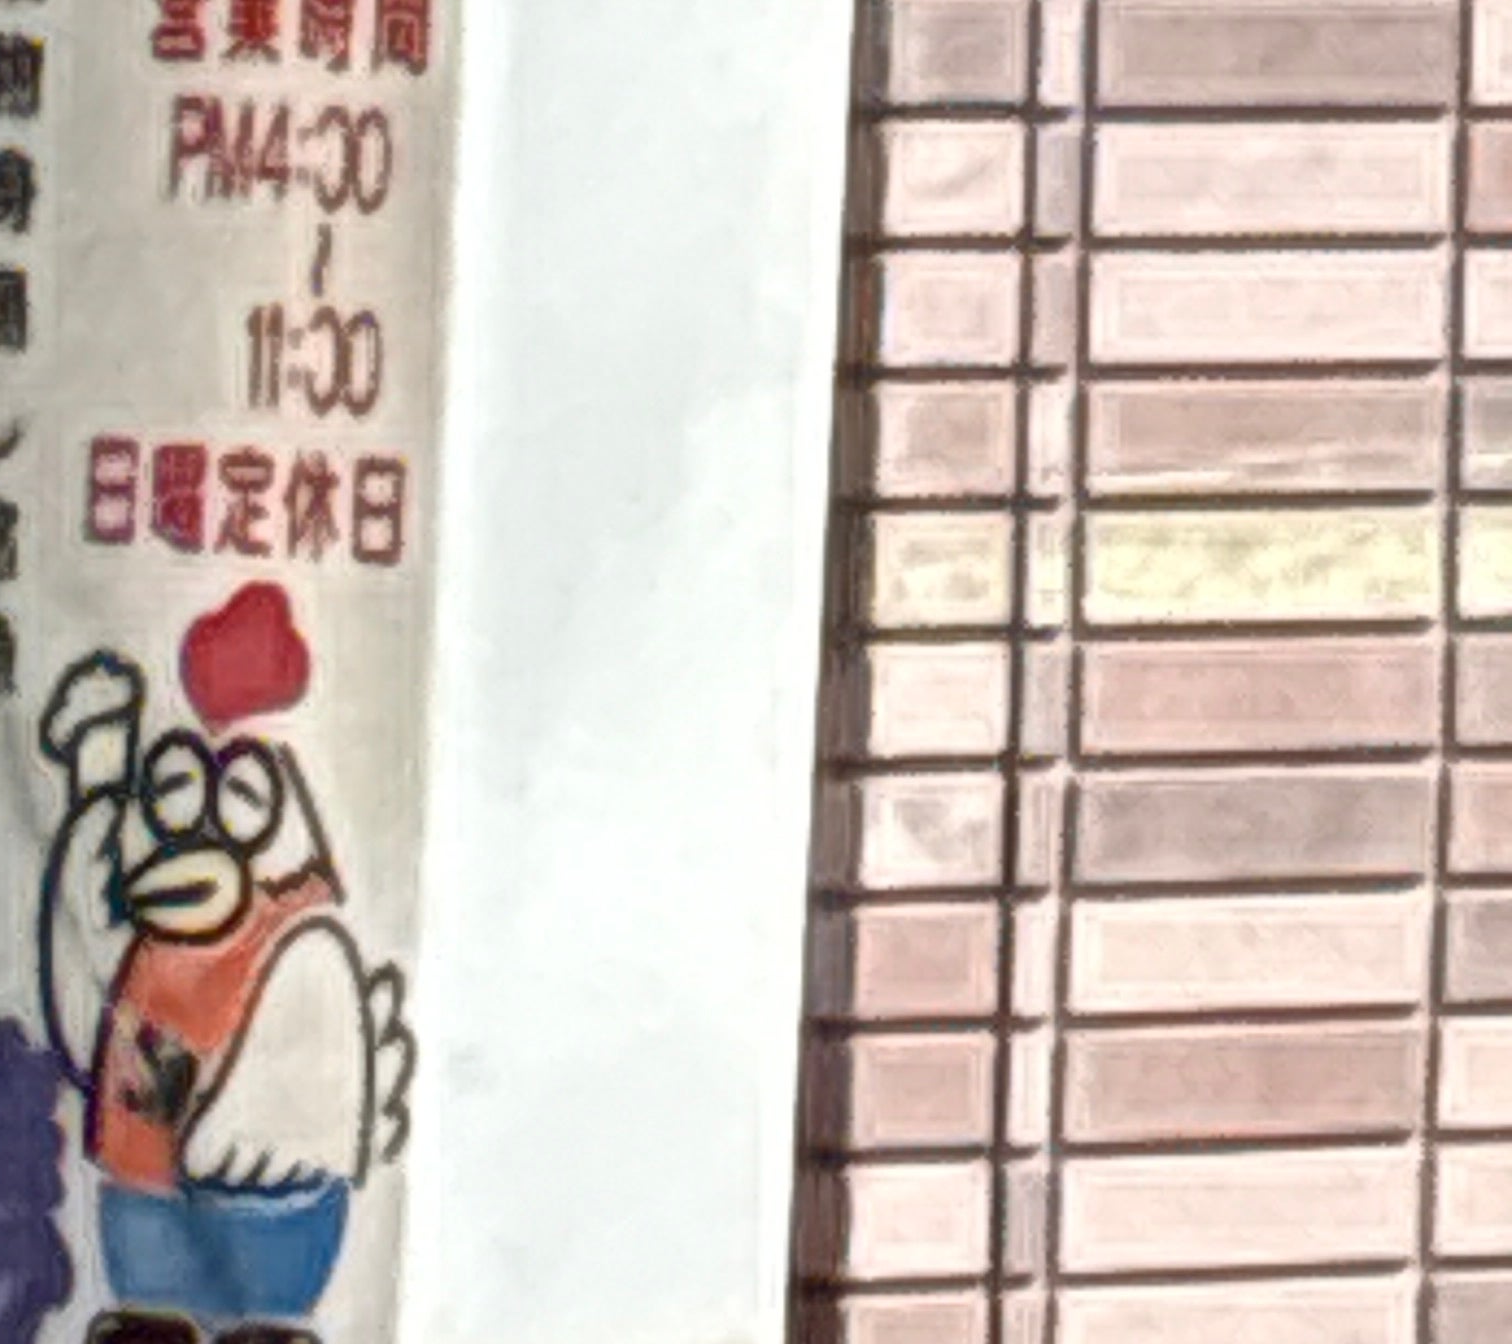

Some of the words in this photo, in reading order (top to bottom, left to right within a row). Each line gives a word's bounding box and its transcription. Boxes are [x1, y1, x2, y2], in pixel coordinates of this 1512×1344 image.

[83, 435, 407, 567] 日曜定休日
